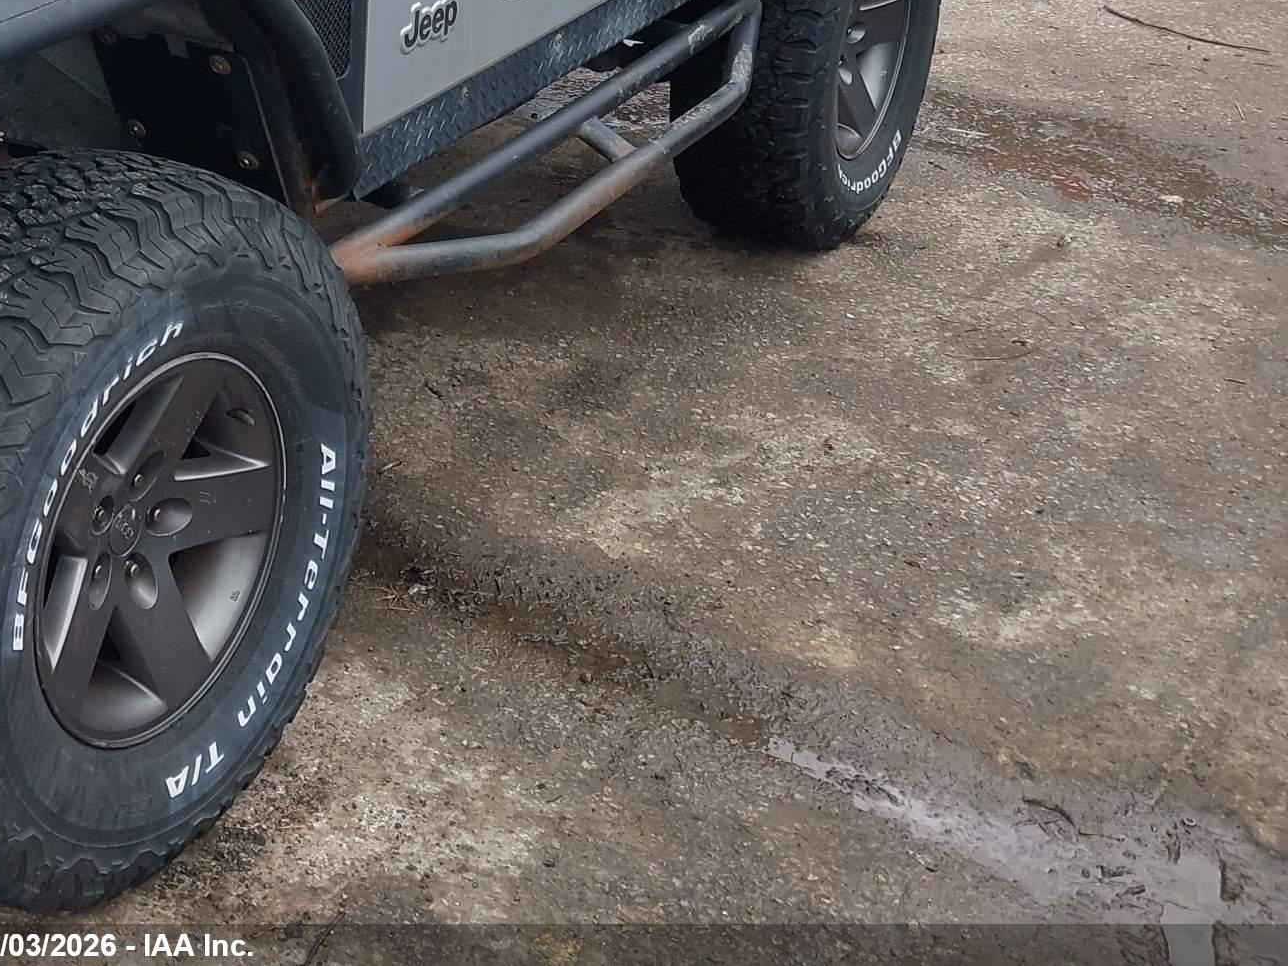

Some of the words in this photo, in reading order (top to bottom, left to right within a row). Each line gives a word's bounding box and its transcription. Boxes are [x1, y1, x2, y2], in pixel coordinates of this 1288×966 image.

[11, 319, 185, 652] BFGoodrich
[236, 442, 338, 730] All-Terrain
[164, 740, 225, 800] T/A
